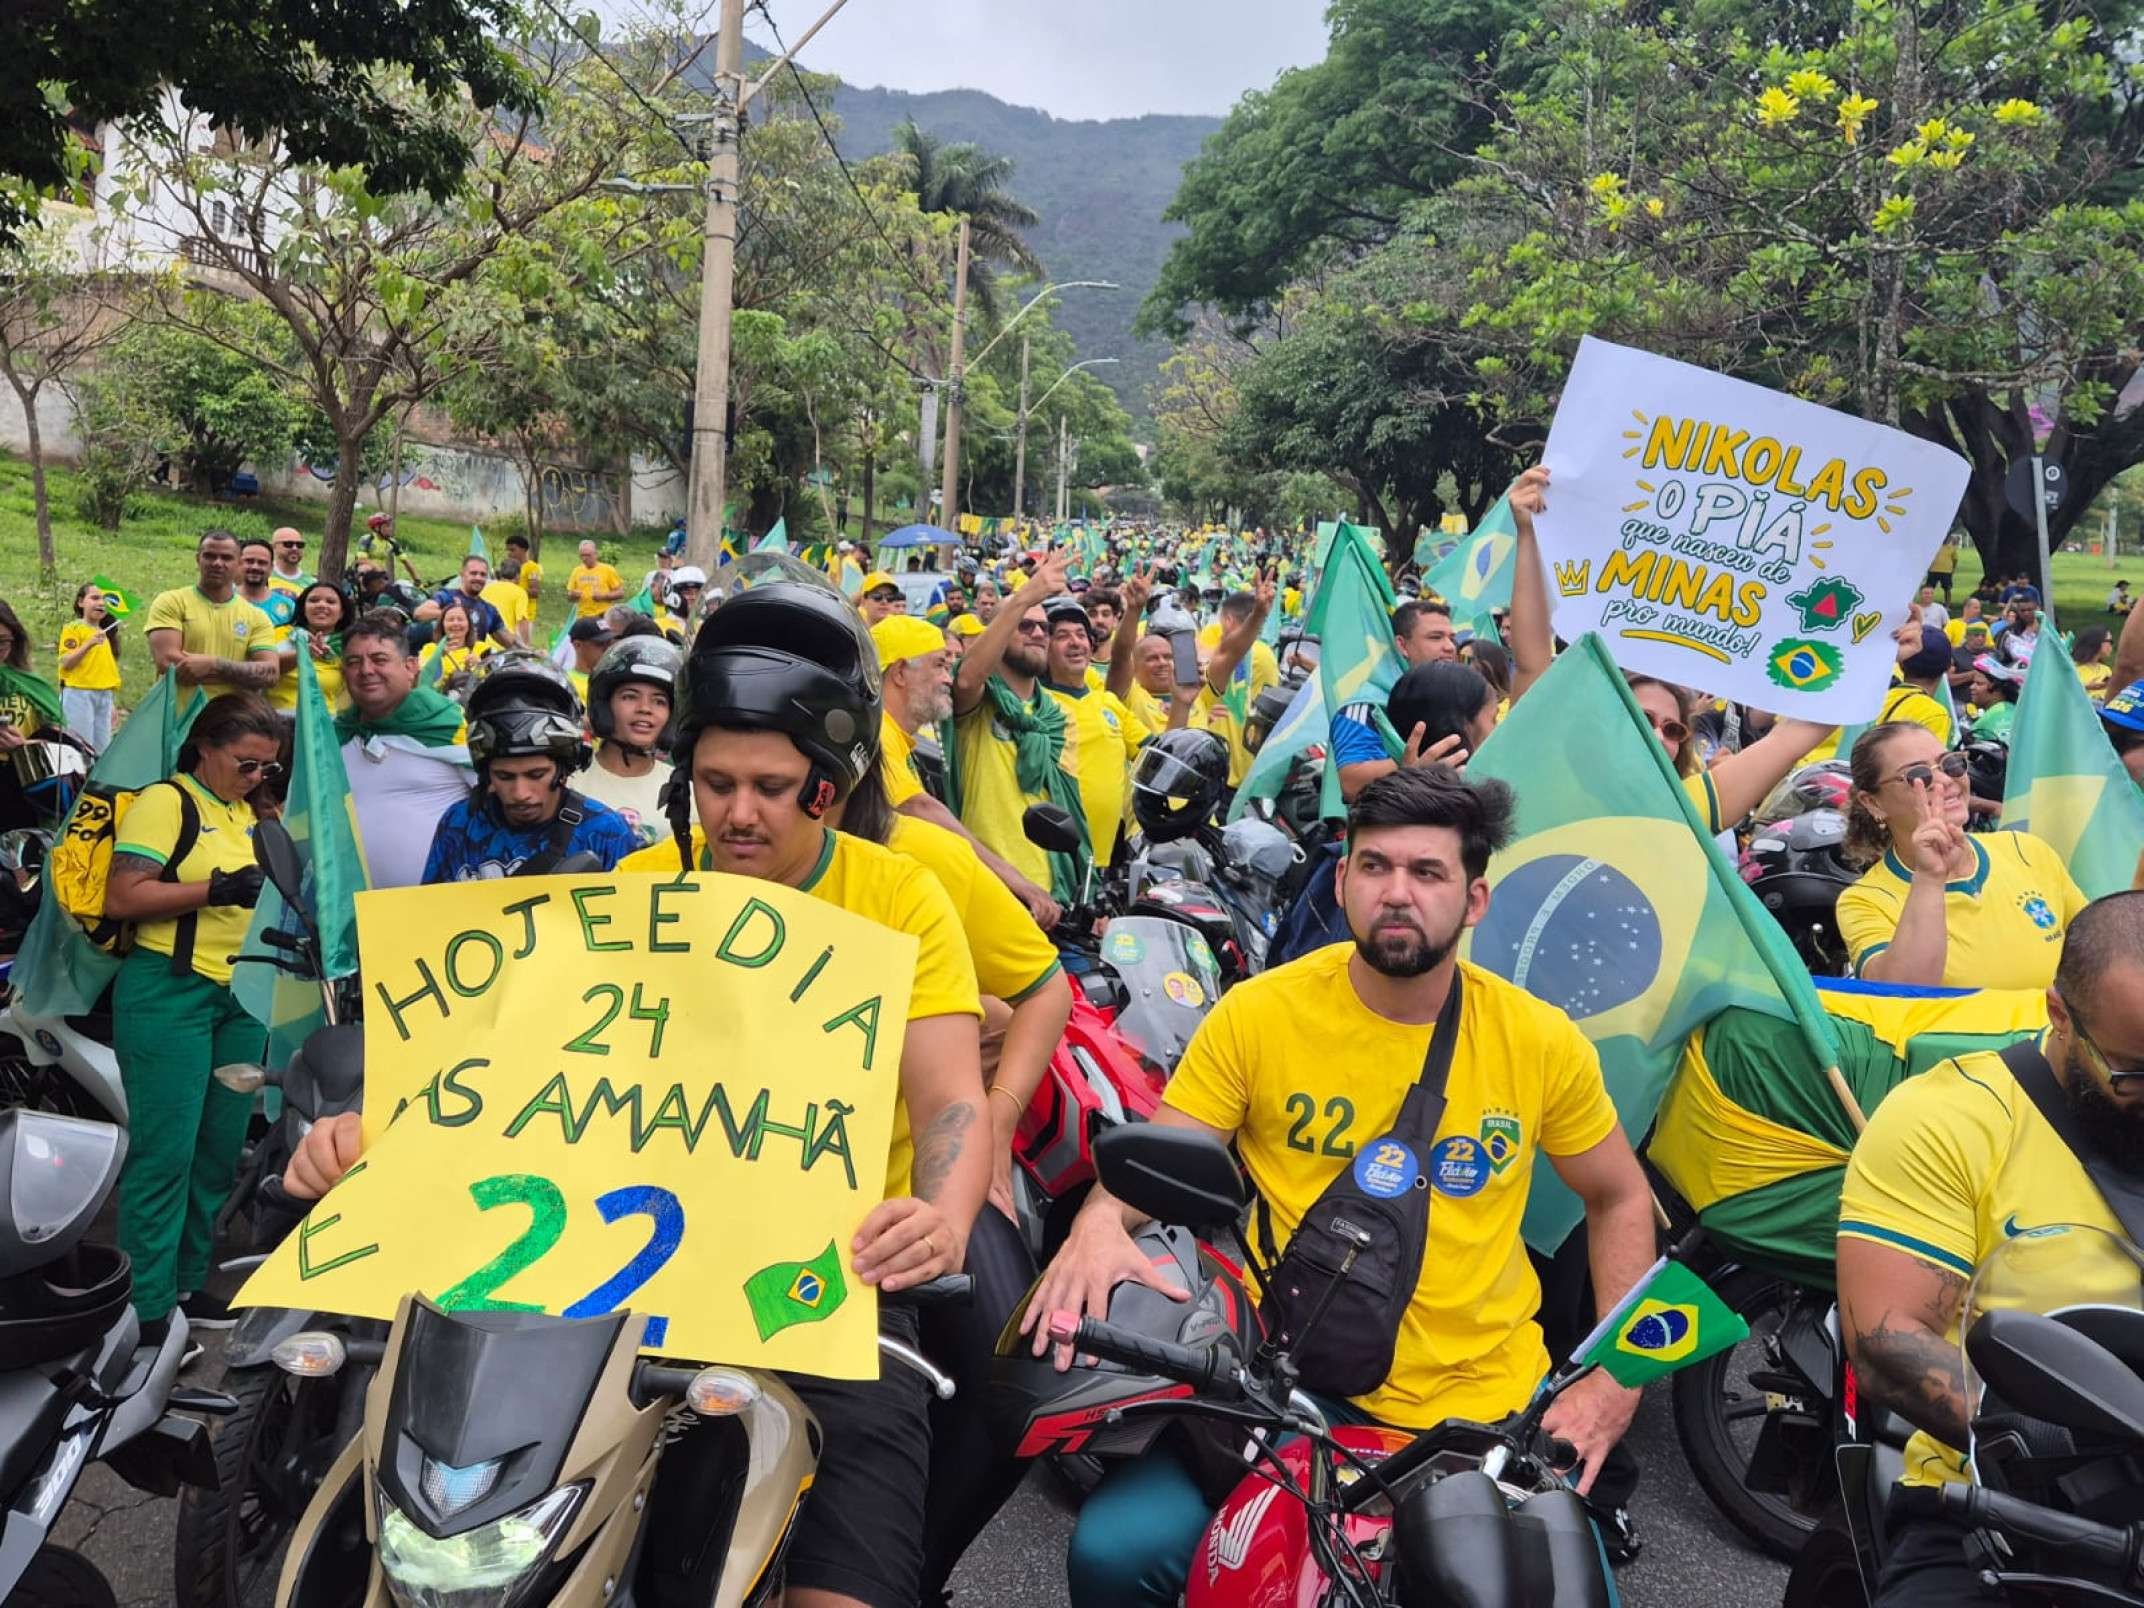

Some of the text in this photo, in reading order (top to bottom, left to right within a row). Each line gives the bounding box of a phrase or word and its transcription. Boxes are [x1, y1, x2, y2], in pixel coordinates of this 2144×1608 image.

[1642, 415, 1888, 520] NIKOLAS
[1621, 519, 1791, 584] que nasceu de
[1656, 479, 1807, 565] O PIÁ
[1596, 549, 1767, 628] MINAS
[1600, 599, 1761, 658] pro mundo!
[76, 801, 109, 820] 99
[375, 886, 634, 1041] HOJE
[562, 982, 670, 1058] 24
[503, 1072, 858, 1190] AMANHÃ
[1285, 1092, 1356, 1159] 22
[1375, 1145, 1406, 1168] 22
[1446, 1142, 1475, 1161] 22
[435, 1173, 686, 1348] 22
[1208, 1503, 1230, 1590] HONDA
